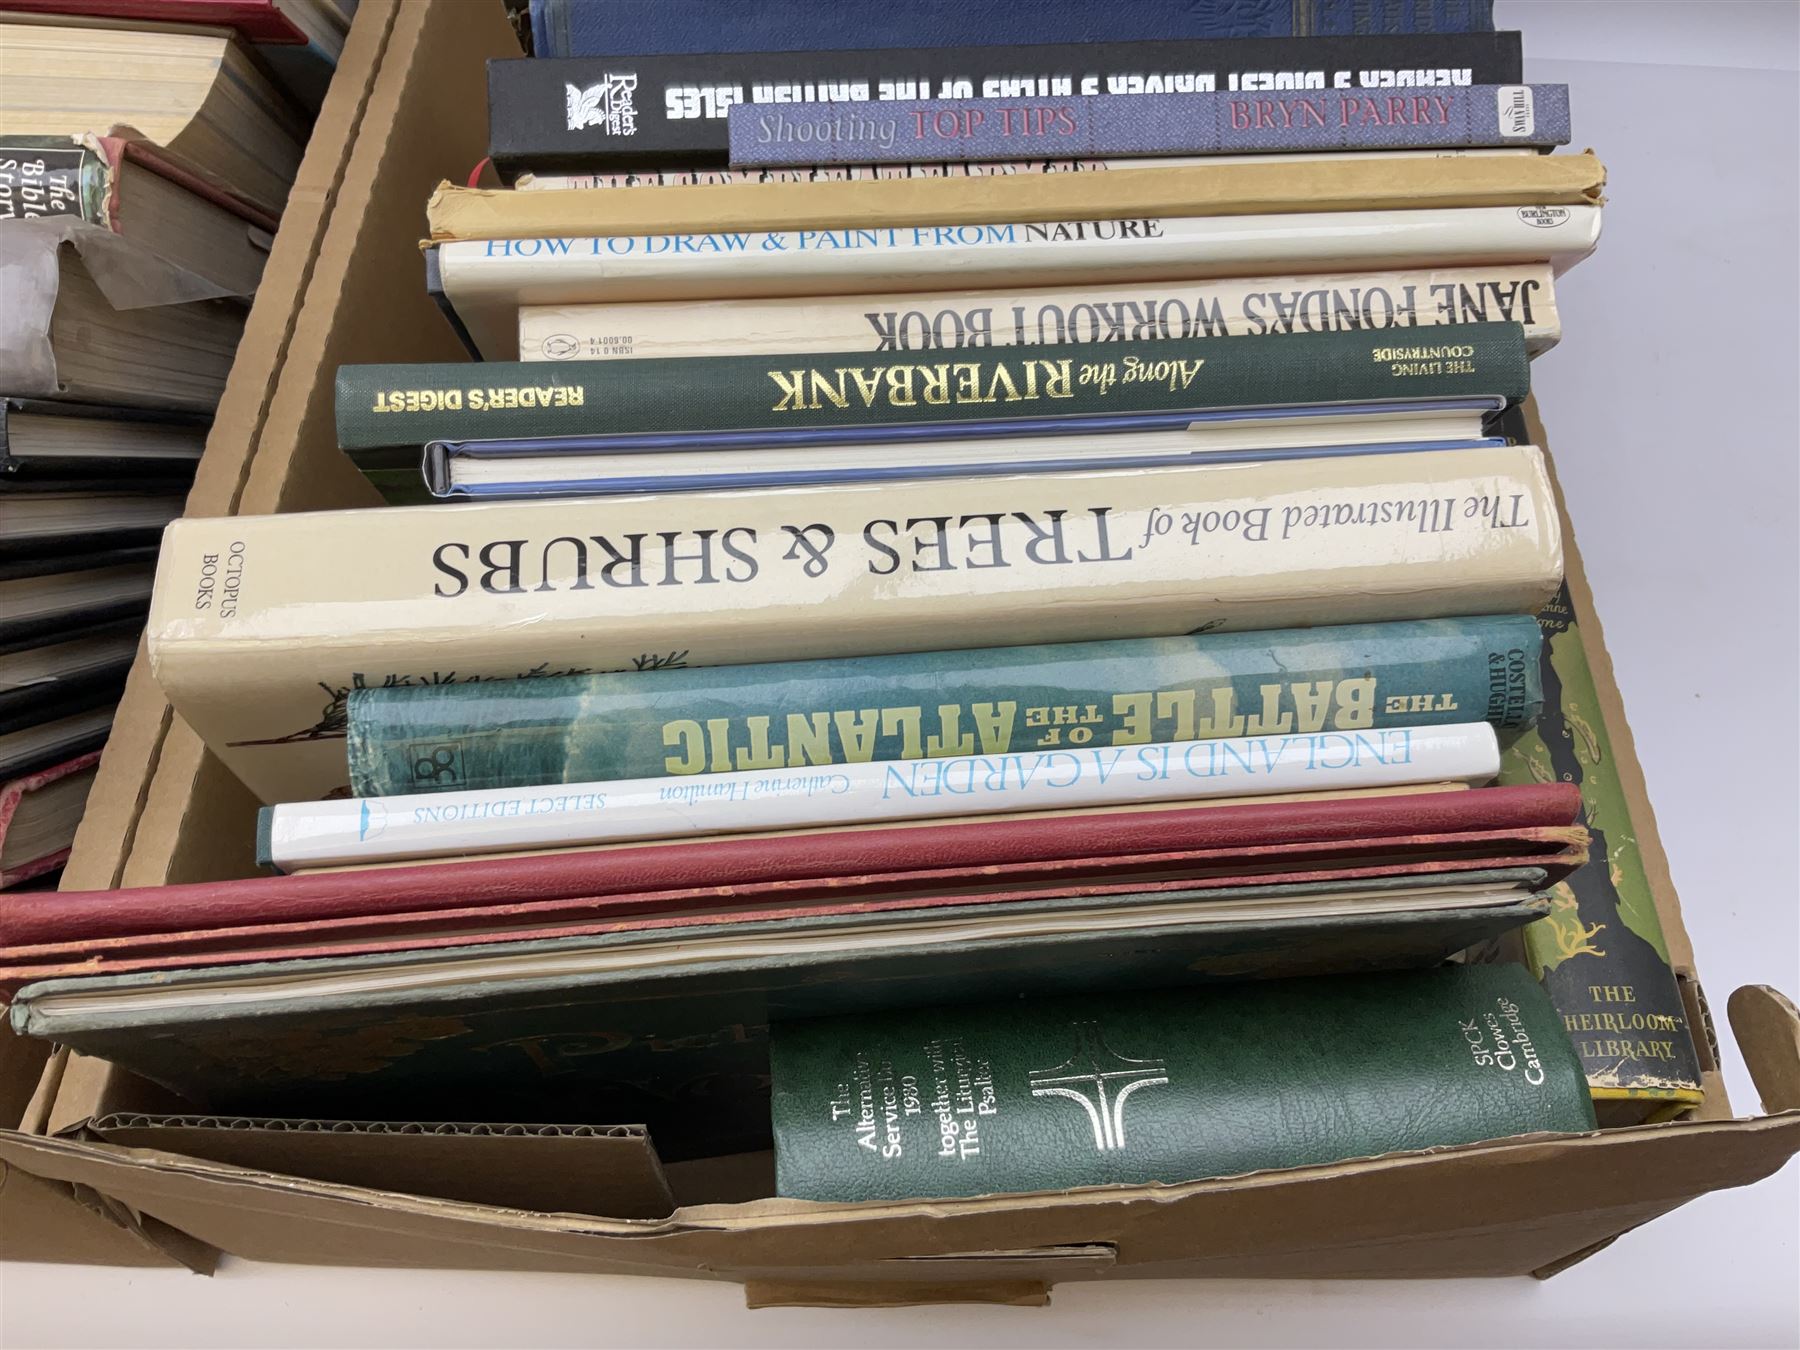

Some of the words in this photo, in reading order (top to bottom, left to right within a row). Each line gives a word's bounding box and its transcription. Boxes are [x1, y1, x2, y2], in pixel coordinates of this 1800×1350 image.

[609, 73, 637, 136] Reader's
[665, 86, 743, 119] ISLES
[1512, 89, 1526, 108] HILL
[609, 100, 622, 136] Digest
[757, 112, 897, 149] Shooting
[909, 110, 985, 139] TOP
[995, 106, 1077, 137] TIPS
[1229, 99, 1327, 130] BRYN
[1339, 95, 1455, 127] PARRY
[1511, 110, 1527, 133] SWAN
[22, 160, 47, 219] Bible
[50, 175, 75, 210] The
[485, 238, 575, 257] HOW
[586, 235, 637, 255] TO
[644, 233, 753, 253] DRAW
[762, 231, 790, 251] &
[798, 227, 903, 250] PAINT
[911, 223, 1017, 246] FROM
[1023, 218, 1164, 242] NATURE
[1431, 279, 1541, 326] JANE
[864, 308, 993, 351] BOOK
[1003, 296, 1229, 347] WORKOUT
[590, 346, 600, 355] 14
[603, 347, 609, 355] 0
[612, 346, 633, 355] ISBN
[1372, 346, 1475, 362] COUNTRYSIDE
[1391, 362, 1442, 376] LIVING
[1445, 361, 1475, 374] THE
[768, 359, 1075, 411] RIVERBANK
[1079, 362, 1117, 395] the
[1121, 356, 1205, 392] Along
[373, 389, 463, 412] DIGEST
[468, 386, 584, 411] READER'S
[1139, 508, 1173, 549] of
[1182, 508, 1272, 545] Book
[1282, 498, 1456, 540] Illustrated
[1464, 494, 1529, 528] The
[781, 523, 835, 578] &
[863, 507, 1132, 575] TREES
[220, 541, 246, 618] OCTOPUS
[432, 527, 759, 598] SHRUBS
[195, 553, 219, 610] BOOKS
[1488, 652, 1505, 665] &
[1026, 705, 1104, 726] THE
[1111, 678, 1377, 745] BATTLE
[1386, 694, 1458, 714] THE
[663, 701, 1017, 775] ATLANTIC
[1037, 727, 1094, 746] OF
[1185, 729, 1413, 776] ENGLAND
[882, 751, 1082, 799] GARDEN
[1092, 749, 1124, 785] A
[1137, 746, 1170, 783] IS
[659, 780, 749, 806] Hamilton
[755, 774, 850, 797] Catherine
[414, 801, 521, 823] EDITIONS
[528, 793, 607, 816] SELECT
[1588, 986, 1636, 1002] THE
[1483, 1012, 1517, 1071] Clowes
[1497, 997, 1545, 1086] Cambridge
[1563, 1012, 1678, 1034] HEIRLOOM
[1458, 1018, 1494, 1066] SPCK
[1580, 1040, 1675, 1062] LIBRARY
[830, 1083, 851, 1121] The
[901, 1075, 922, 1117] 1980
[879, 1086, 902, 1158] Service
[931, 1077, 960, 1156] together
[959, 1119, 980, 1160] The
